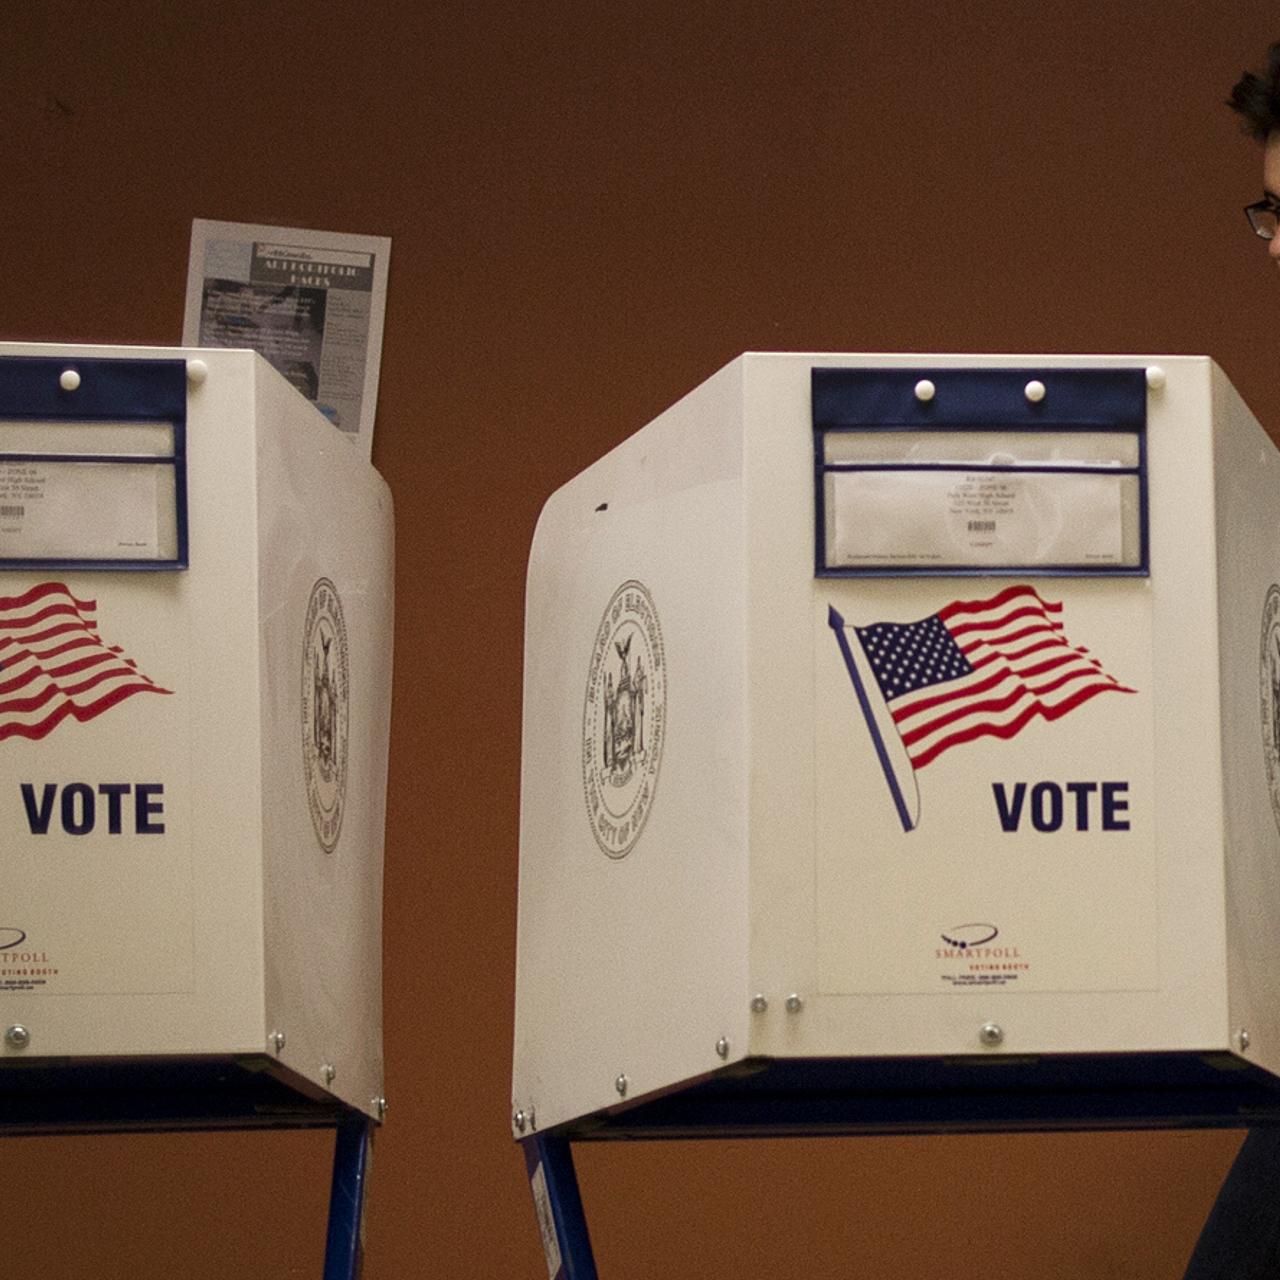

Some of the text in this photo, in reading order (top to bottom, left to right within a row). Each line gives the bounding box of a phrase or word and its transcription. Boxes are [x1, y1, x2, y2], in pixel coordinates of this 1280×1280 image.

[20, 783, 165, 835] VOTE
[991, 781, 1130, 832] VOTE
[935, 947, 1021, 959] SMARTPOLL
